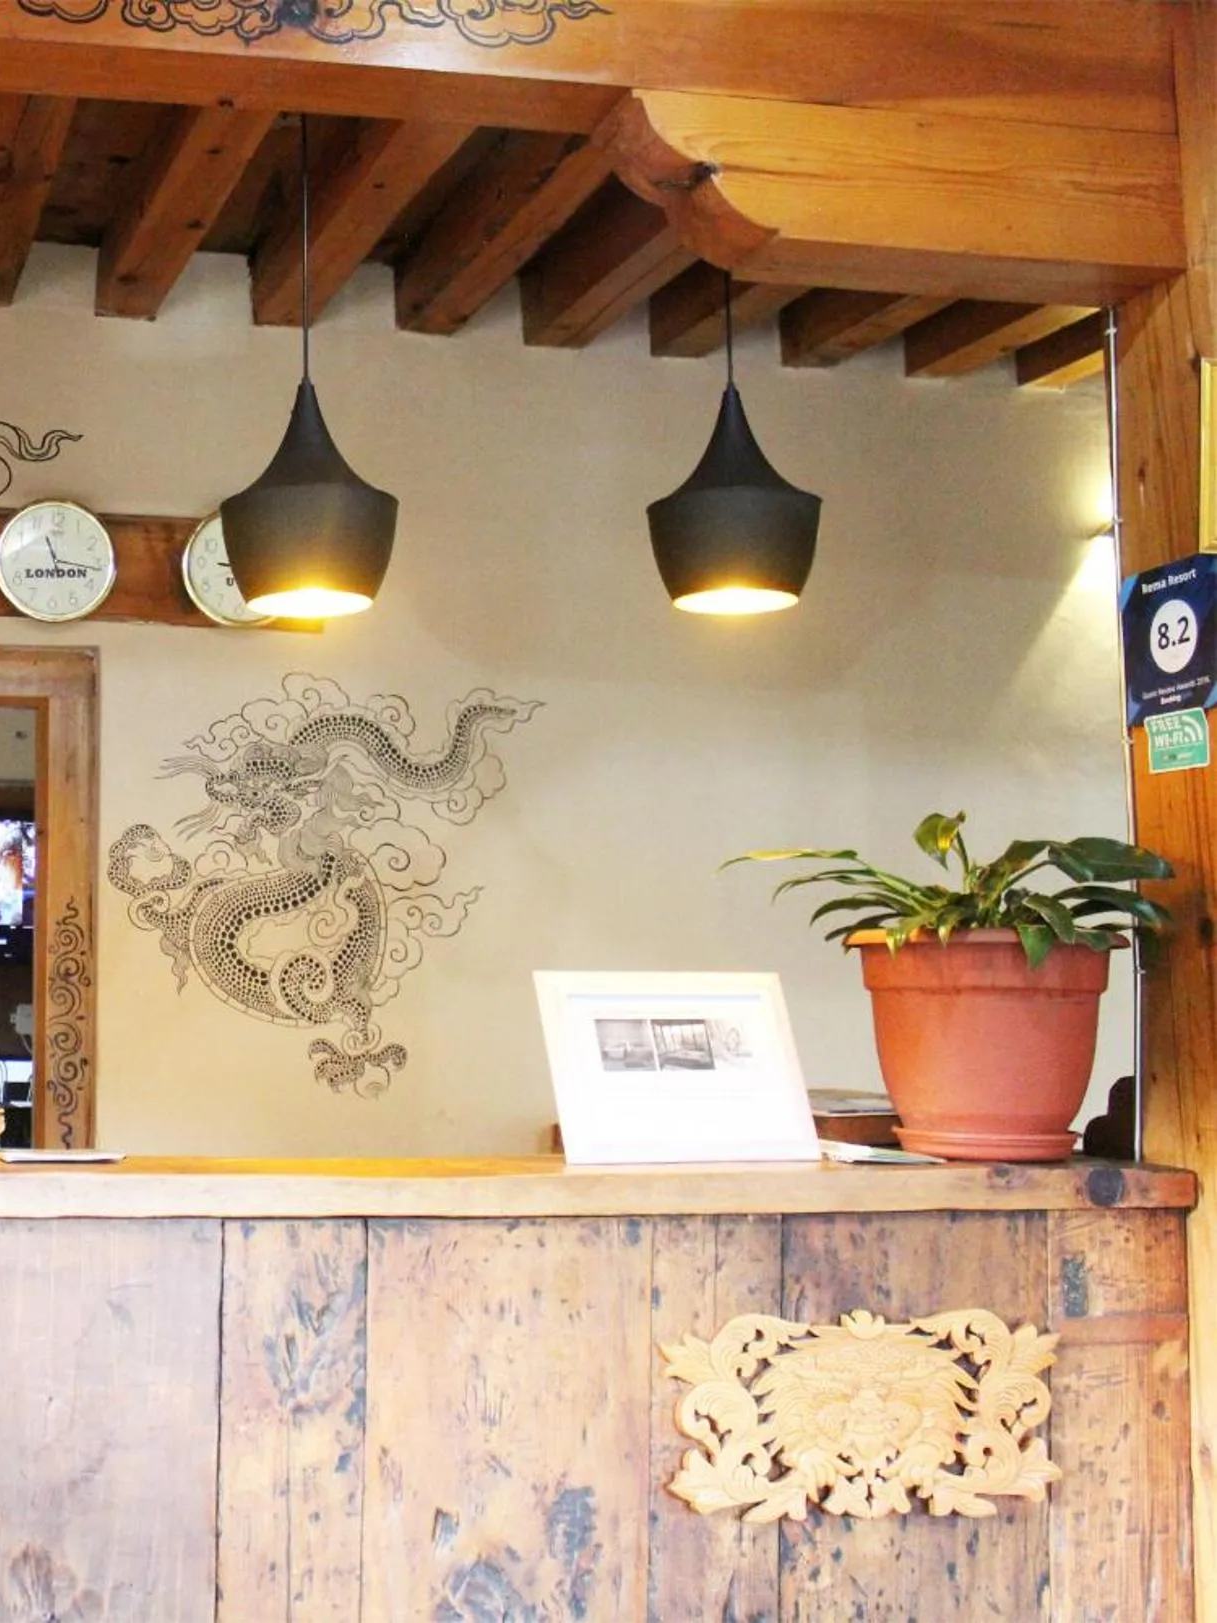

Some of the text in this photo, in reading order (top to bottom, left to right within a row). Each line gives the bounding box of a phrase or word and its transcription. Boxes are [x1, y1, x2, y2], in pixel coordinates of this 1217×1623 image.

[86, 536, 98, 551] 2
[25, 568, 87, 578] LONDON
[1142, 568, 1197, 594] Rema Resort
[1157, 616, 1190, 649] 8.2
[1150, 715, 1182, 733] FREE
